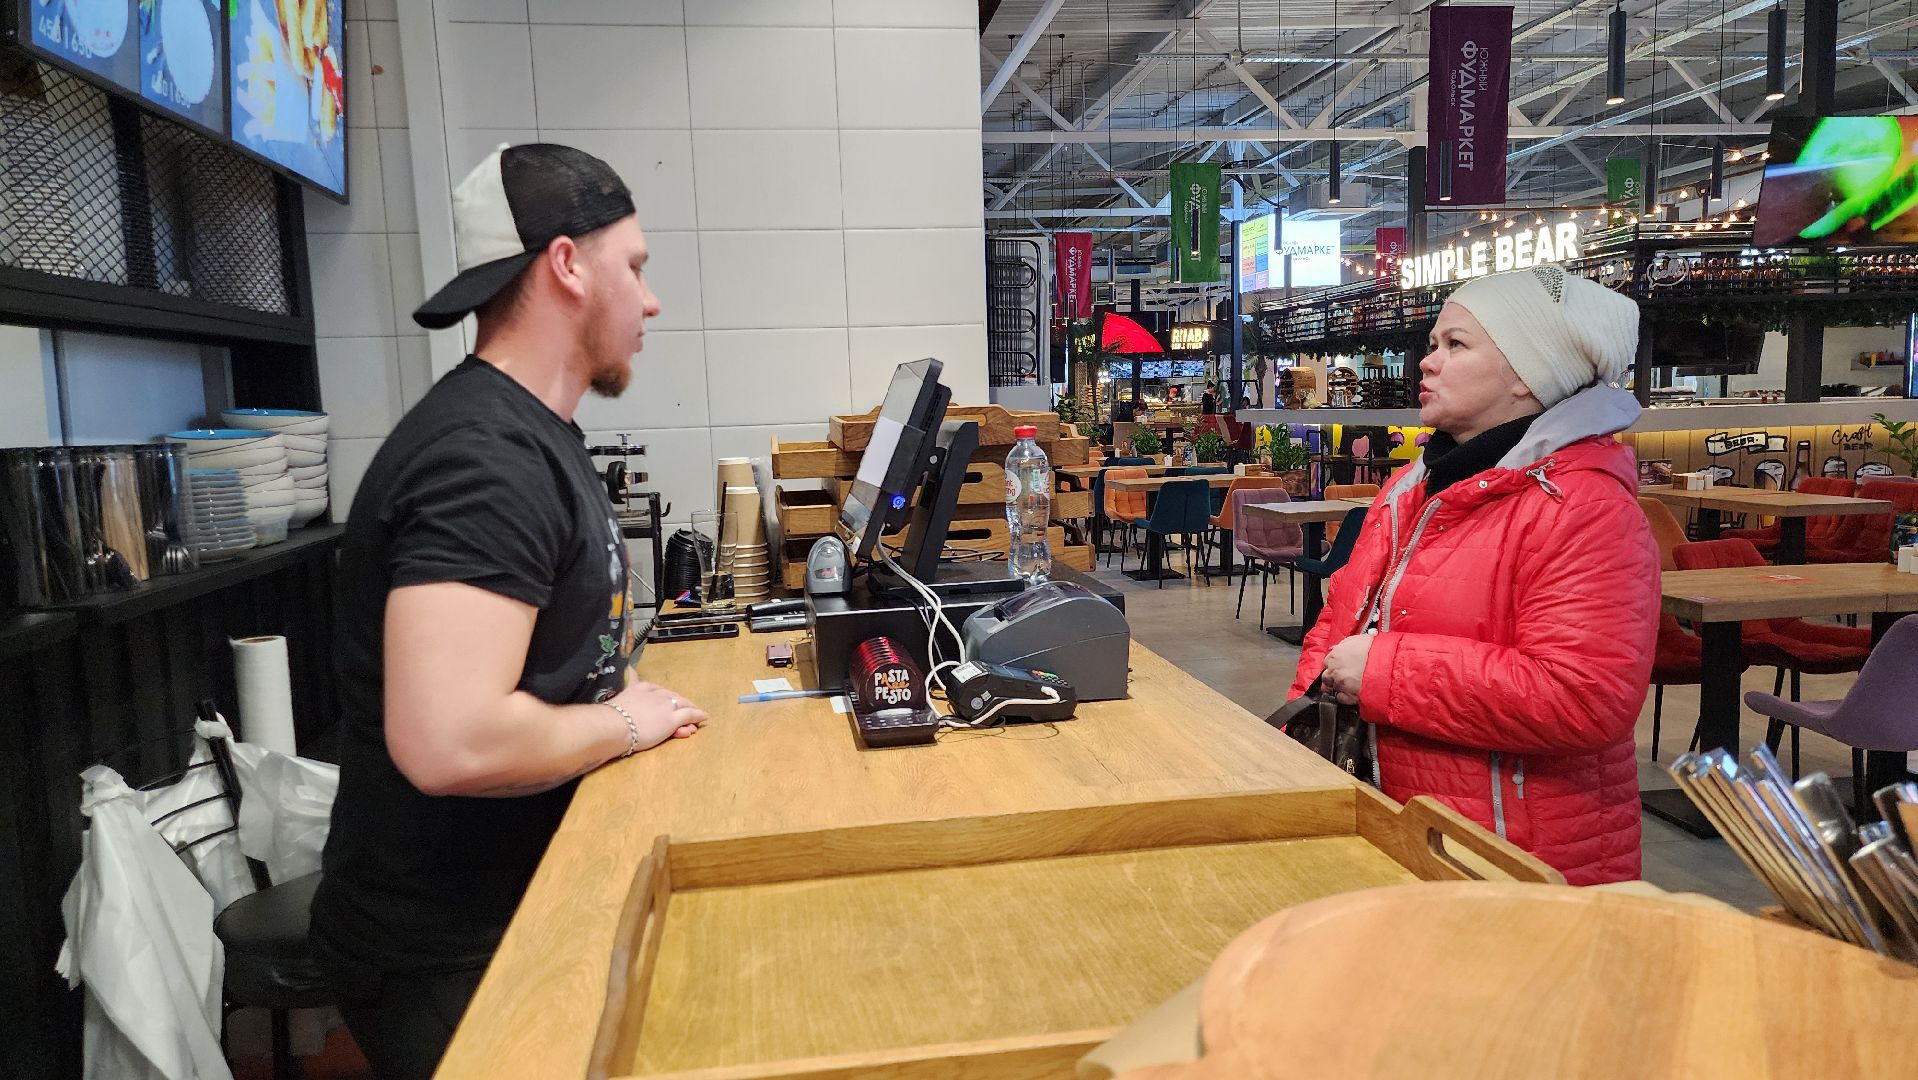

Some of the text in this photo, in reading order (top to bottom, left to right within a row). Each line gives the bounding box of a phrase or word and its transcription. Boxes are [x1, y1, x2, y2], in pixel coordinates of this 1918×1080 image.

[1478, 47, 1489, 91] ЮЖНЫЙ
[1458, 40, 1478, 171] ФУДМАРКЕТ
[1401, 221, 1579, 290] SIMPLE BEAR
[1068, 246, 1078, 303] ФУДМАРКЕ
[1831, 424, 1872, 445] Craft
[1843, 442, 1874, 451] BEER
[874, 669, 909, 686] PASTA
[875, 686, 911, 704] PESTO
